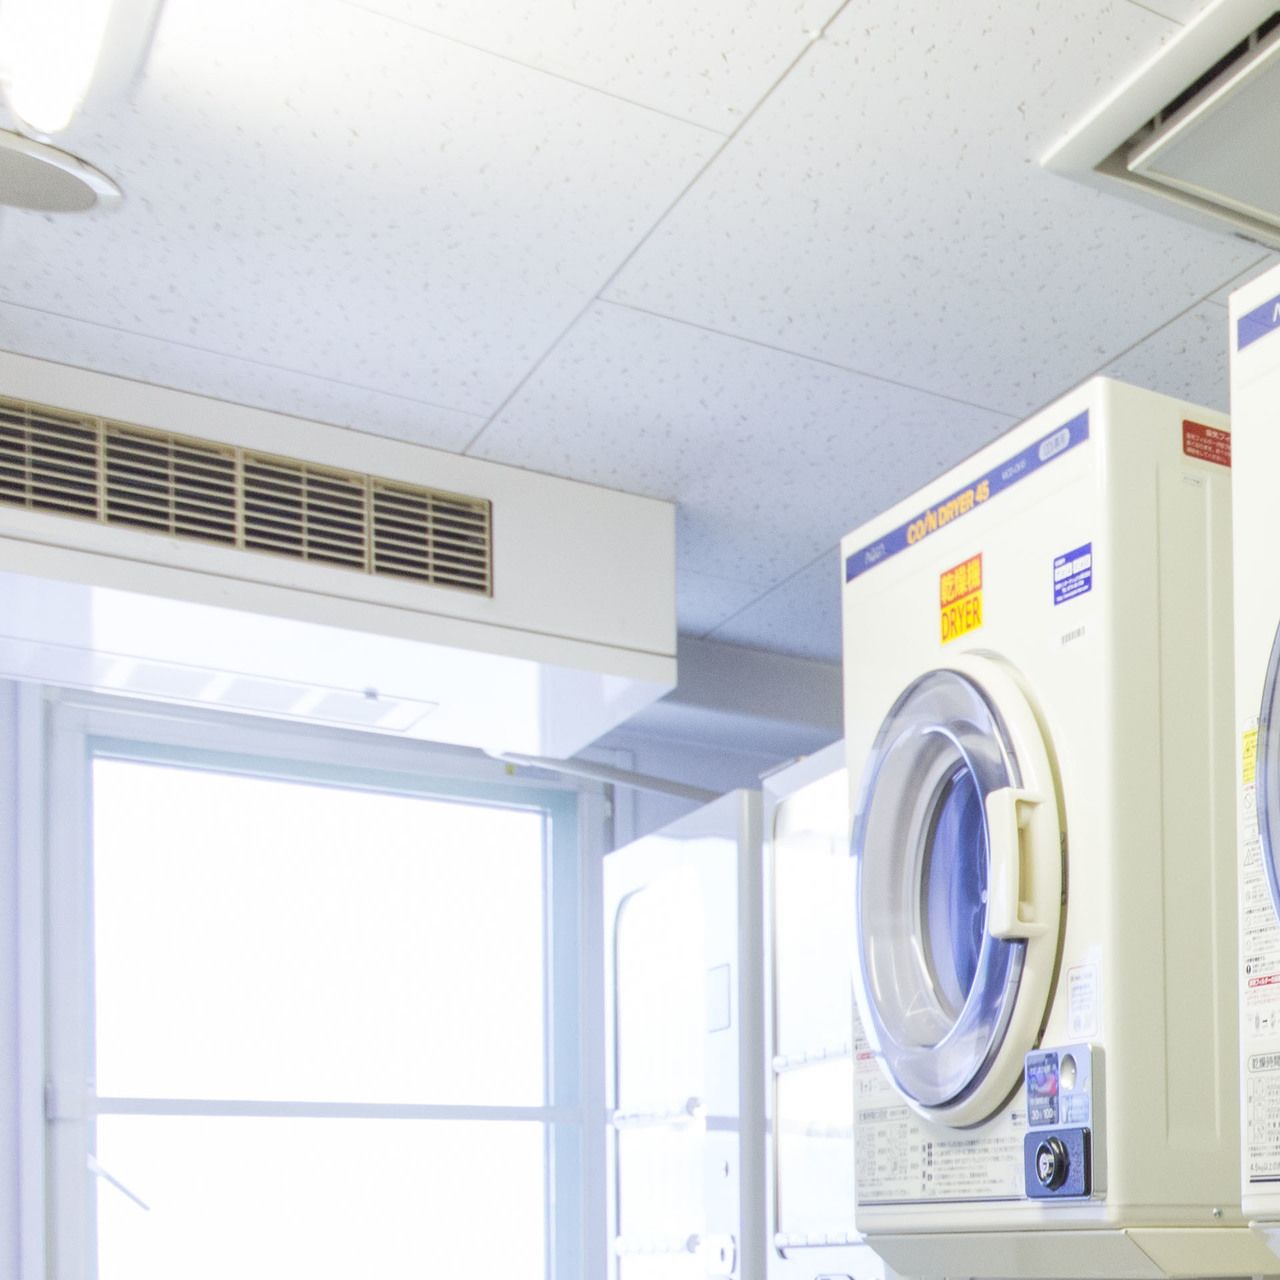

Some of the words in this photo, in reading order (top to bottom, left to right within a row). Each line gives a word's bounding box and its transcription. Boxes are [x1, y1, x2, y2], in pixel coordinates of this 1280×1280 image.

[939, 490, 974, 527] DRYER
[975, 480, 990, 502] 45
[942, 597, 981, 640] DRYER
